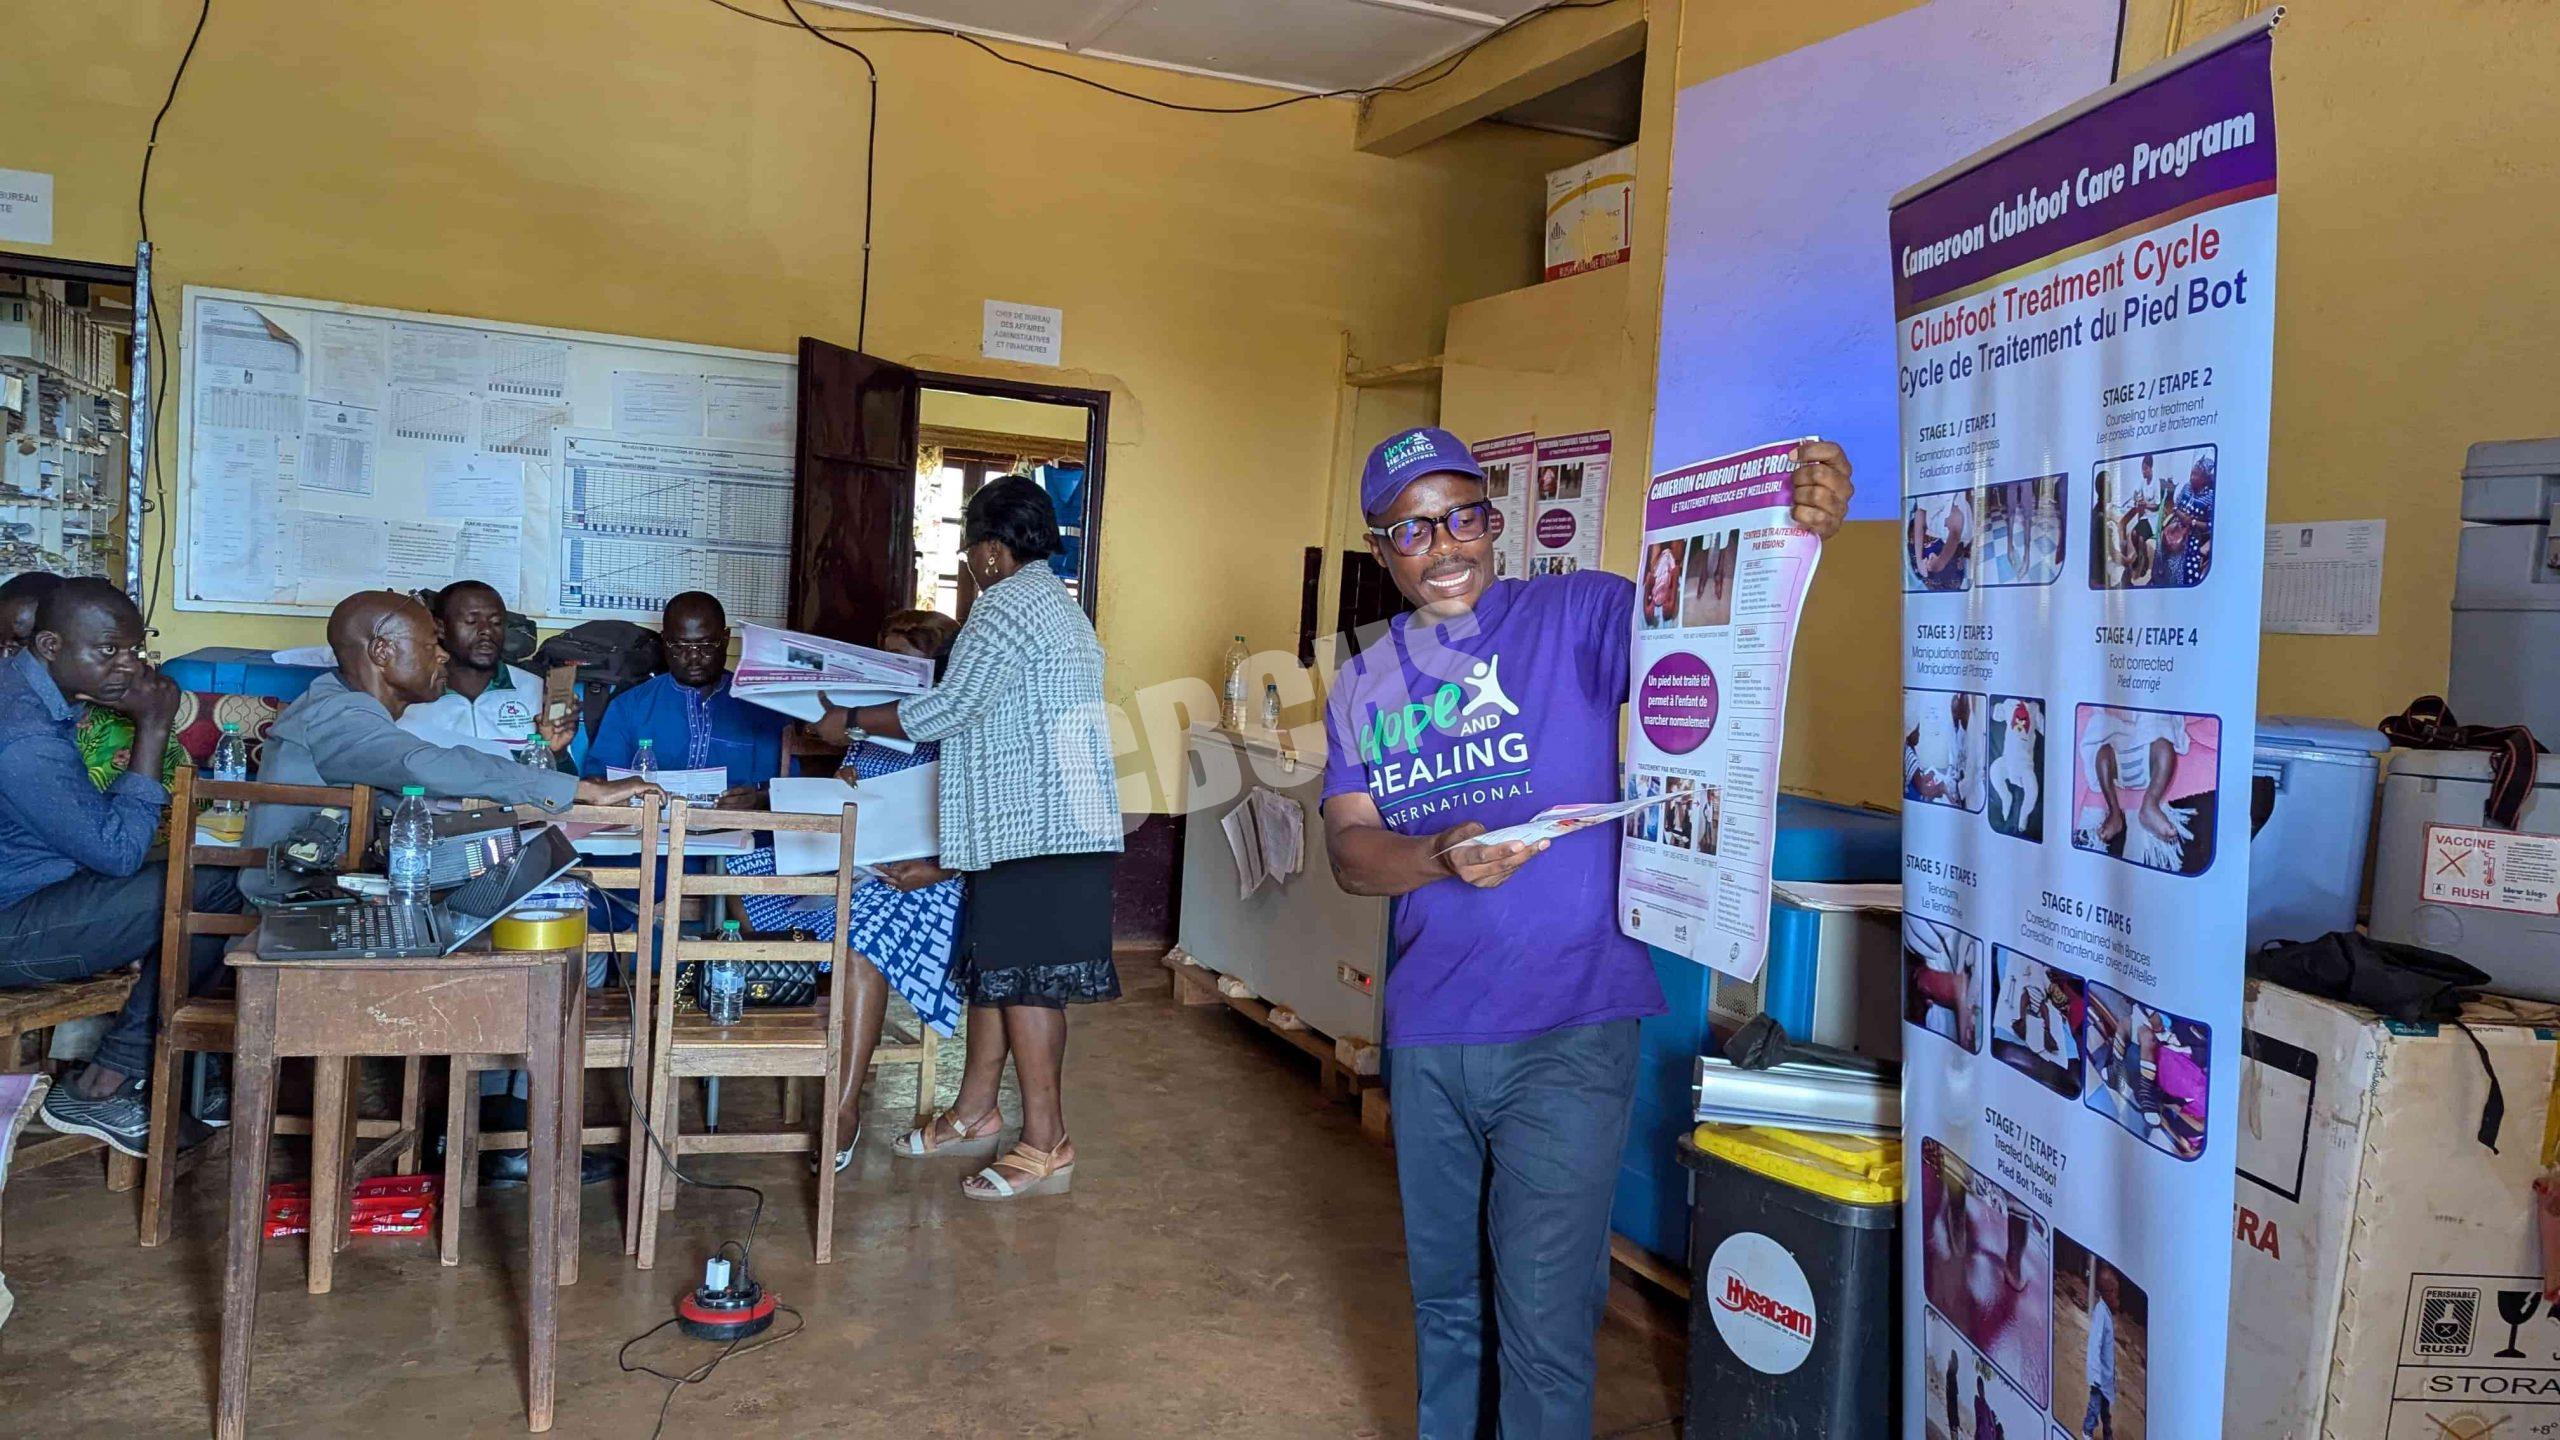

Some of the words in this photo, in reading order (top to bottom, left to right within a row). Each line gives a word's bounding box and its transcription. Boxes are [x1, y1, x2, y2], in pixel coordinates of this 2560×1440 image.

[1902, 223, 1985, 279] Cameroon
[1989, 179, 2070, 243] Clubfoot
[2076, 163, 2125, 208] Care
[2131, 111, 2255, 186] Program
[1911, 296, 1996, 351] Clubfoot
[2003, 251, 2125, 322] Treatment
[2134, 223, 2220, 286] Cycle
[994, 330, 1050, 344] ADMINISTRATIVES
[1000, 321, 1014, 329] DES
[1015, 323, 1045, 333] AFFAIRES
[1900, 358, 1944, 398] Cycle
[1950, 351, 1972, 380] de
[1978, 315, 2082, 373] Traitement
[2091, 307, 2116, 342] du
[2124, 284, 2179, 333] Pied
[2188, 268, 2247, 315] Bot
[2103, 383, 2135, 407] STAGE
[2138, 381, 2146, 399] 2
[2148, 379, 2156, 400] /
[2159, 369, 2199, 395] ETAPE
[2203, 367, 2213, 386] 2
[2106, 408, 2146, 427] Counseling
[2148, 405, 2159, 418] for
[2161, 396, 2205, 417] treatment
[1919, 423, 1947, 442] STAGE
[1950, 422, 1955, 437] 1
[1957, 421, 1963, 437] /
[1965, 413, 1990, 434] ETAPE
[1991, 412, 1996, 428] 1
[2136, 423, 2157, 438] pour
[2158, 421, 2166, 433] le
[2168, 410, 2219, 431] traitement
[1386, 443, 1434, 468] HEALING
[1956, 443, 1970, 456] and
[1955, 462, 1962, 474] et
[1651, 475, 1694, 500] CAMEROON
[1694, 464, 1739, 491] CLUBFOOT
[1739, 461, 1762, 480] CARE
[1671, 503, 1678, 514] LE
[1678, 496, 1710, 512] TRAITEMENT
[1710, 491, 1735, 505] PRECOCE
[1735, 488, 1746, 500] EST
[1747, 480, 1782, 496] MEILLEUR!
[1767, 527, 1809, 538] TRAITEMENT
[1917, 625, 1947, 639] STAGE
[1949, 625, 1955, 640] 3
[1956, 625, 1962, 641] /
[1963, 625, 1986, 640] ETAPE
[1987, 626, 1993, 640] 3
[2095, 627, 2125, 644] STAGE
[2126, 627, 2134, 644] 4
[2135, 628, 2143, 647] /
[2145, 628, 2184, 646] ETAPE
[2188, 628, 2198, 646] 4
[1912, 646, 1960, 661] Manipulation
[2109, 653, 2125, 669] Foot
[2127, 656, 2174, 672] corrected
[1648, 675, 1657, 687] Un
[1657, 675, 1672, 689] pied
[1672, 675, 1683, 687] bot
[1683, 674, 1700, 687] traité
[1700, 674, 1710, 687] tôt
[2118, 674, 2131, 688] Pied
[2132, 676, 2161, 693] corrigé
[1648, 695, 1669, 709] permet
[1675, 694, 1698, 708] l'enfant
[1699, 696, 1708, 708] de
[1359, 682, 1461, 765] Hope
[1460, 713, 1500, 737] AND
[1644, 714, 1669, 726] marcher
[1669, 716, 1710, 728] normalement
[1369, 732, 1529, 799] HEALING
[1387, 781, 1533, 828] NTERNATIONAL
[2436, 835, 2496, 850] VACCINE
[1906, 854, 1932, 873] STAGE
[1935, 861, 1941, 875] 5
[1943, 863, 1948, 879] /
[1950, 865, 1971, 886] ETAPE
[1972, 873, 1977, 888] 5
[1922, 896, 1930, 909] Le
[2451, 887, 2490, 900] RUSH
[2042, 891, 2072, 915] STAGE
[2076, 901, 2083, 918] 6
[2086, 904, 2093, 922] /
[2096, 906, 2124, 932] ETAPE
[2125, 917, 2132, 935] 6
[2057, 940, 2104, 964] maintenue
[2061, 925, 2111, 950] maintained
[2124, 944, 2150, 967] Braces
[1985, 1107, 2014, 1138] STAGE
[2016, 1124, 2022, 1141] 7
[2023, 1131, 2028, 1149] /
[2030, 1134, 2058, 1168] ETAPE
[2060, 1154, 2067, 1171] 7
[1994, 1133, 2022, 1164] Treated
[2024, 1153, 2057, 1188] Clubfoot
[1997, 1158, 2014, 1180] Pied
[2016, 1170, 2029, 1191] Bot
[2030, 1181, 2053, 1208] Traité
[2231, 1203, 2280, 1261] RA
[1716, 1275, 1812, 1338] Hysacam
[2426, 1290, 2477, 1299] PERISHABLE
[2420, 1345, 2467, 1354] RUSH
[2429, 1375, 2560, 1395] STORA
